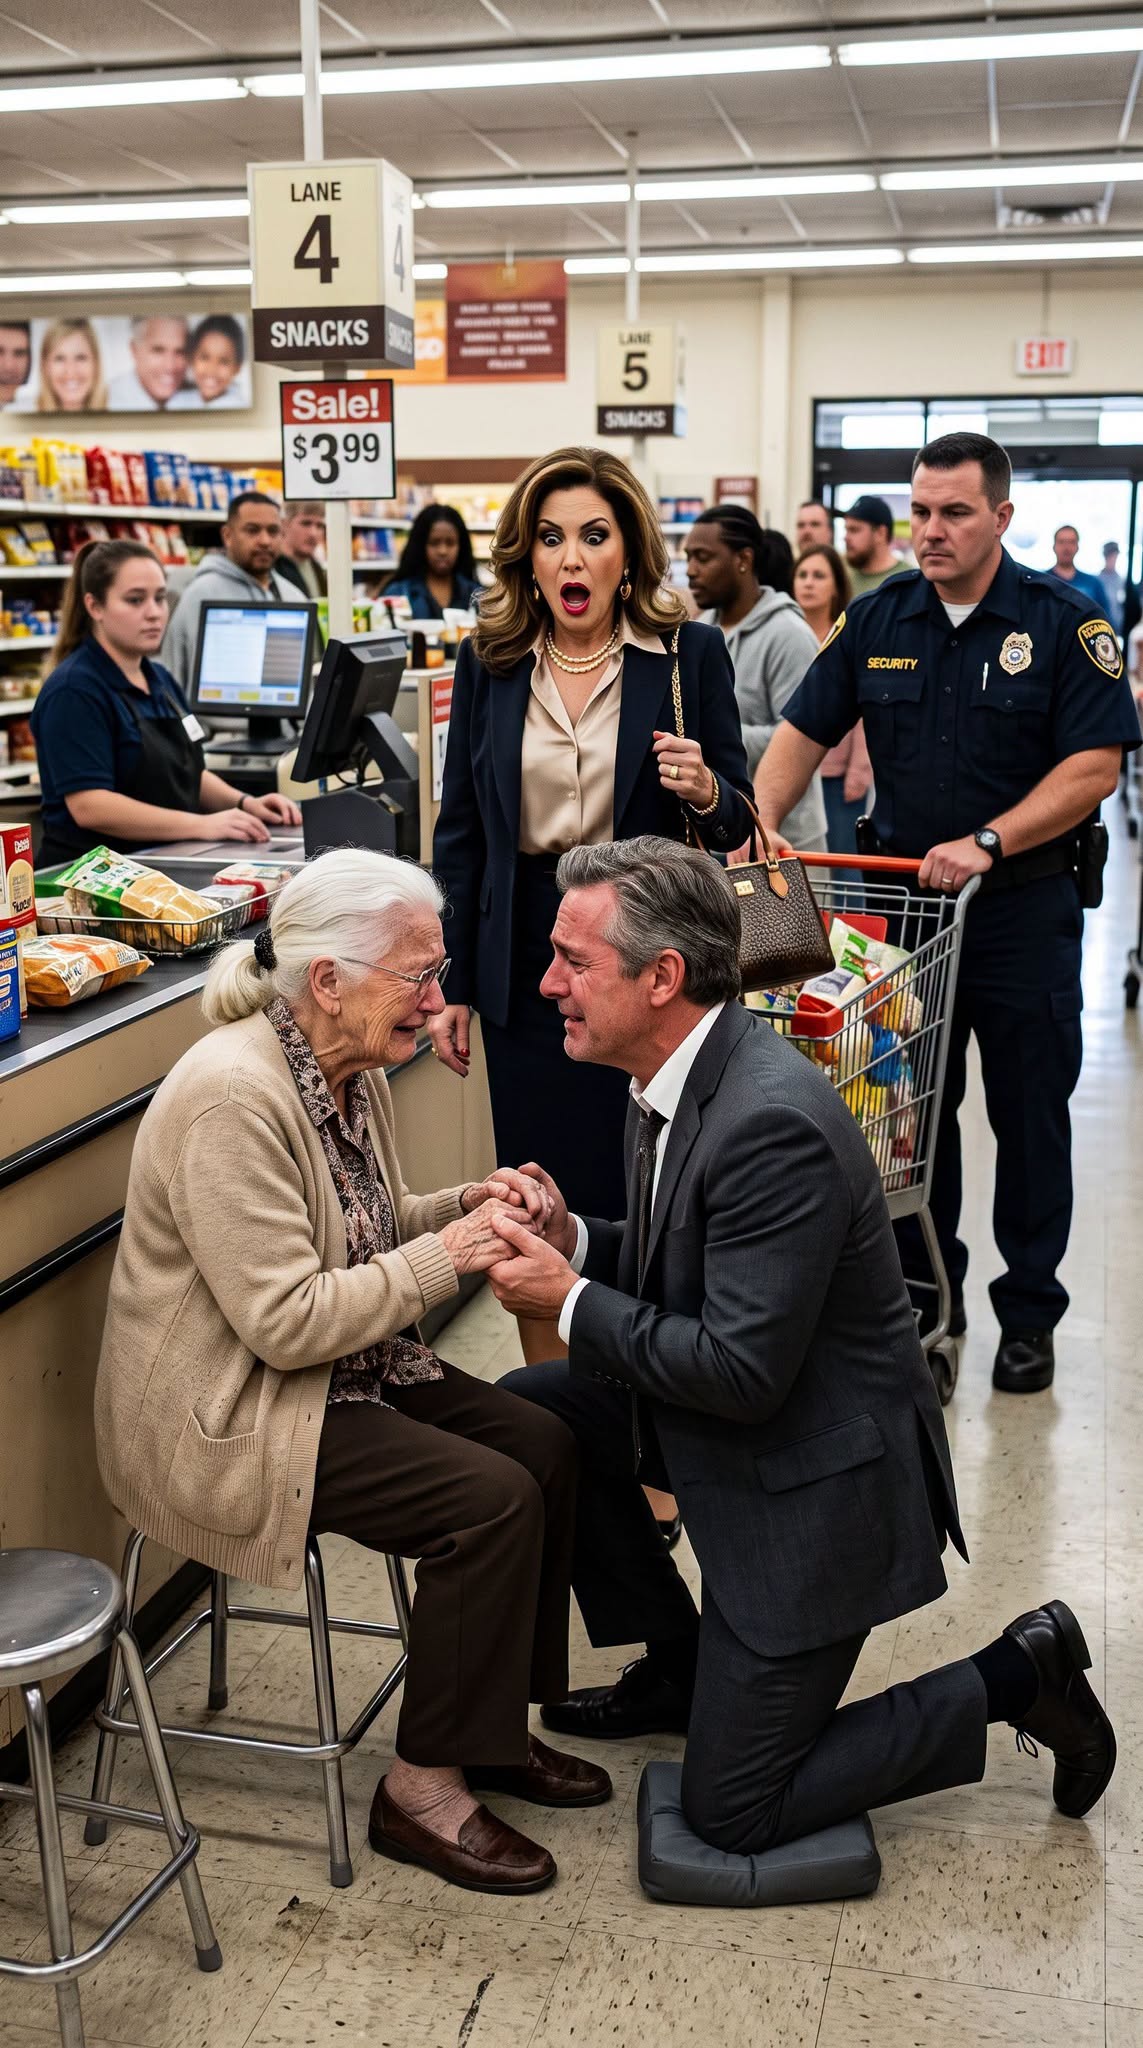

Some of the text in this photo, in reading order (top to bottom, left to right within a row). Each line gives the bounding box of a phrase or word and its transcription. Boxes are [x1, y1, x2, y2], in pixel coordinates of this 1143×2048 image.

[291, 182, 342, 201] LANE
[294, 214, 339, 284] 4
[270, 319, 369, 348] SNACKS
[618, 332, 651, 345] LANE
[1024, 341, 1065, 368] EXIT
[622, 352, 648, 391] 5
[292, 387, 379, 420] Sale!
[604, 410, 666, 428] SNACKS
[867, 657, 918, 670] SECURITY
